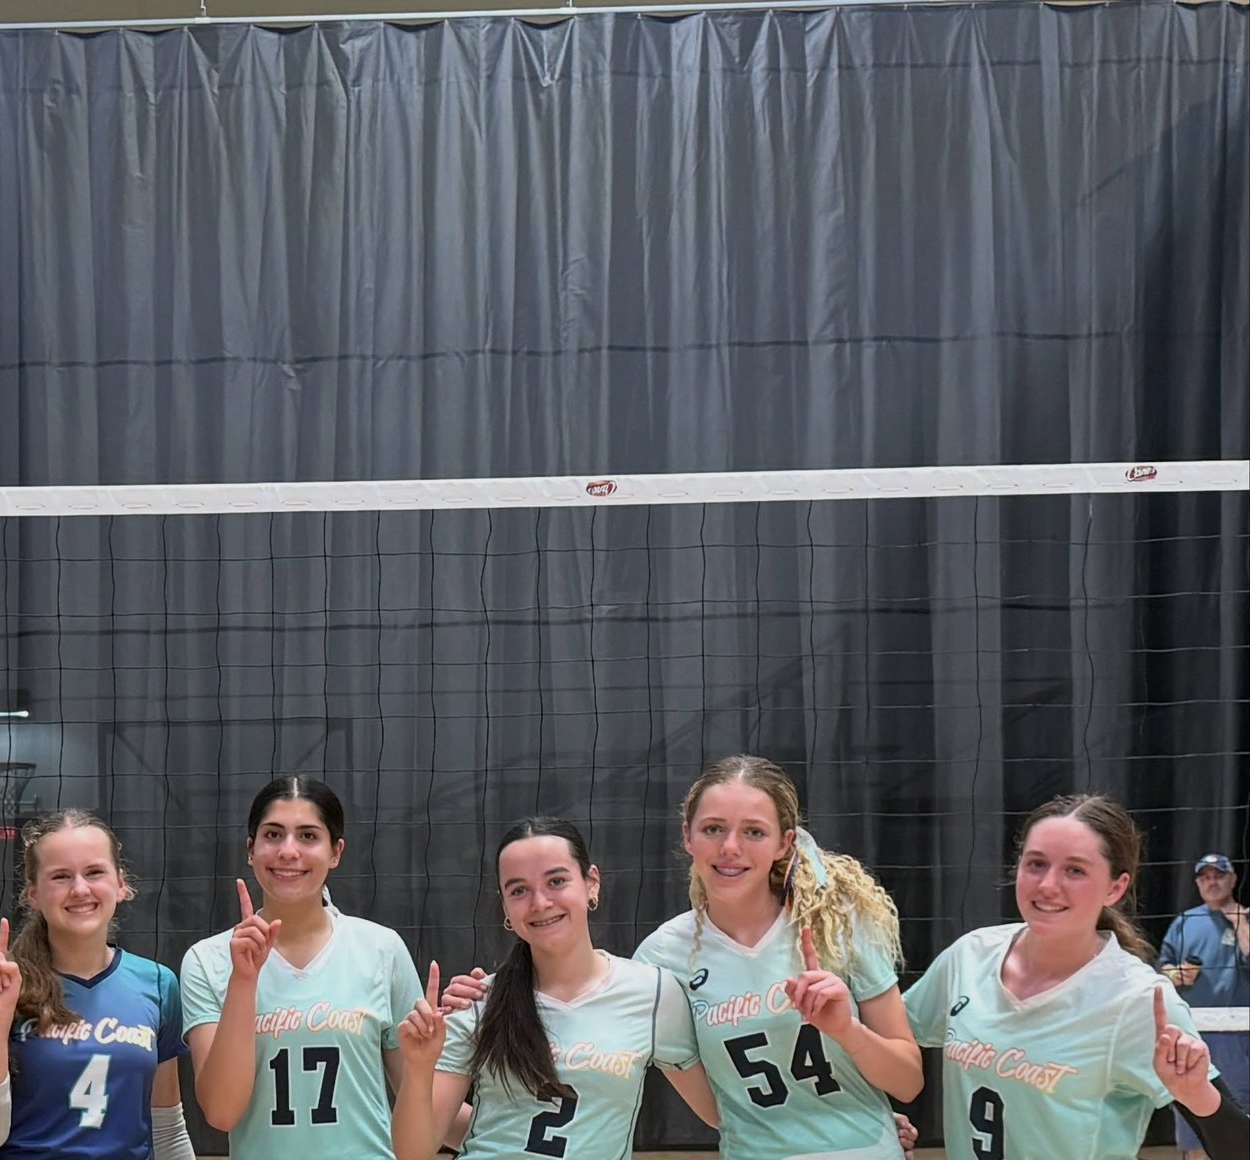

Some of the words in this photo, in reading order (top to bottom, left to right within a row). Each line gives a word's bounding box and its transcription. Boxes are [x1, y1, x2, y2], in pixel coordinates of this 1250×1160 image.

[255, 1005, 303, 1039] acific
[306, 1000, 377, 1036] Coast
[692, 991, 762, 1028] Pacific
[20, 1017, 93, 1046] Pcific
[94, 1017, 156, 1052] Coast
[565, 1042, 642, 1080] Coast
[723, 1022, 842, 1109] 54
[996, 1047, 1079, 1094] Coast
[69, 1053, 112, 1130] 4
[268, 1045, 342, 1128] 17
[524, 1082, 580, 1159] 2
